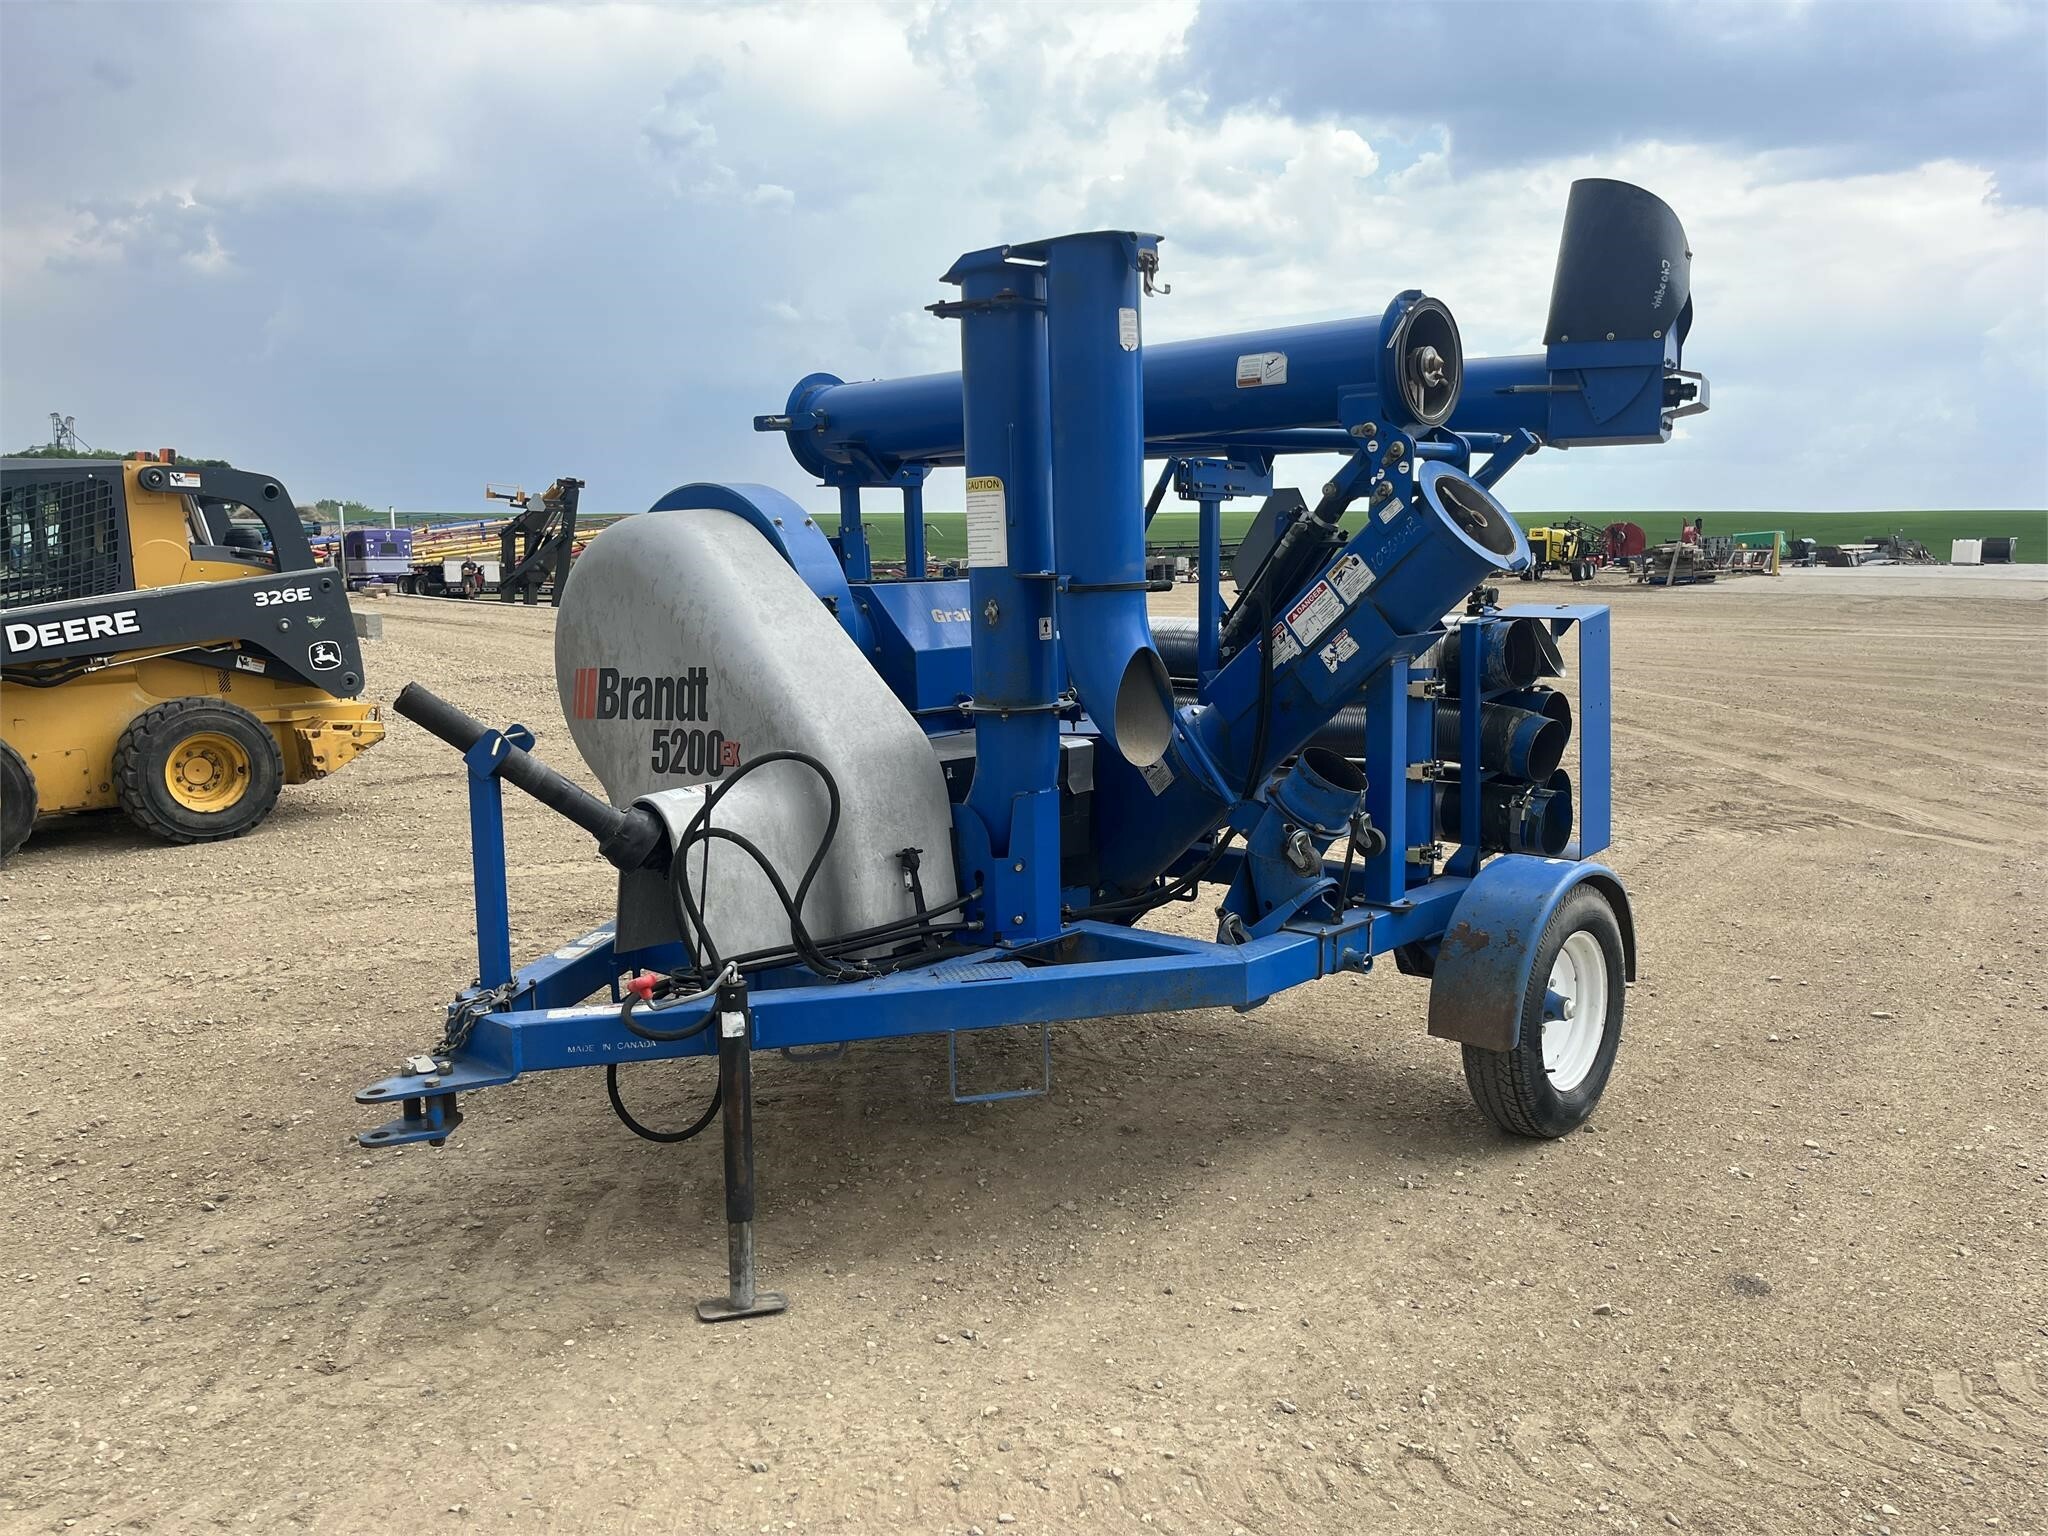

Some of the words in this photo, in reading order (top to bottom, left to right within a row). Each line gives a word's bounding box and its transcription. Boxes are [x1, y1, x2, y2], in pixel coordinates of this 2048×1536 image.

[967, 479, 1000, 490] CAUTION
[254, 587, 313, 607] 326E
[1297, 587, 1324, 615] DANGER
[931, 607, 971, 623] Grai
[5, 610, 141, 653] DEERE
[597, 667, 709, 721] Brandt
[652, 728, 725, 777] 5200
[567, 1044, 595, 1053] MADE
[603, 1043, 611, 1051] IN
[617, 1040, 657, 1050] CANADA
